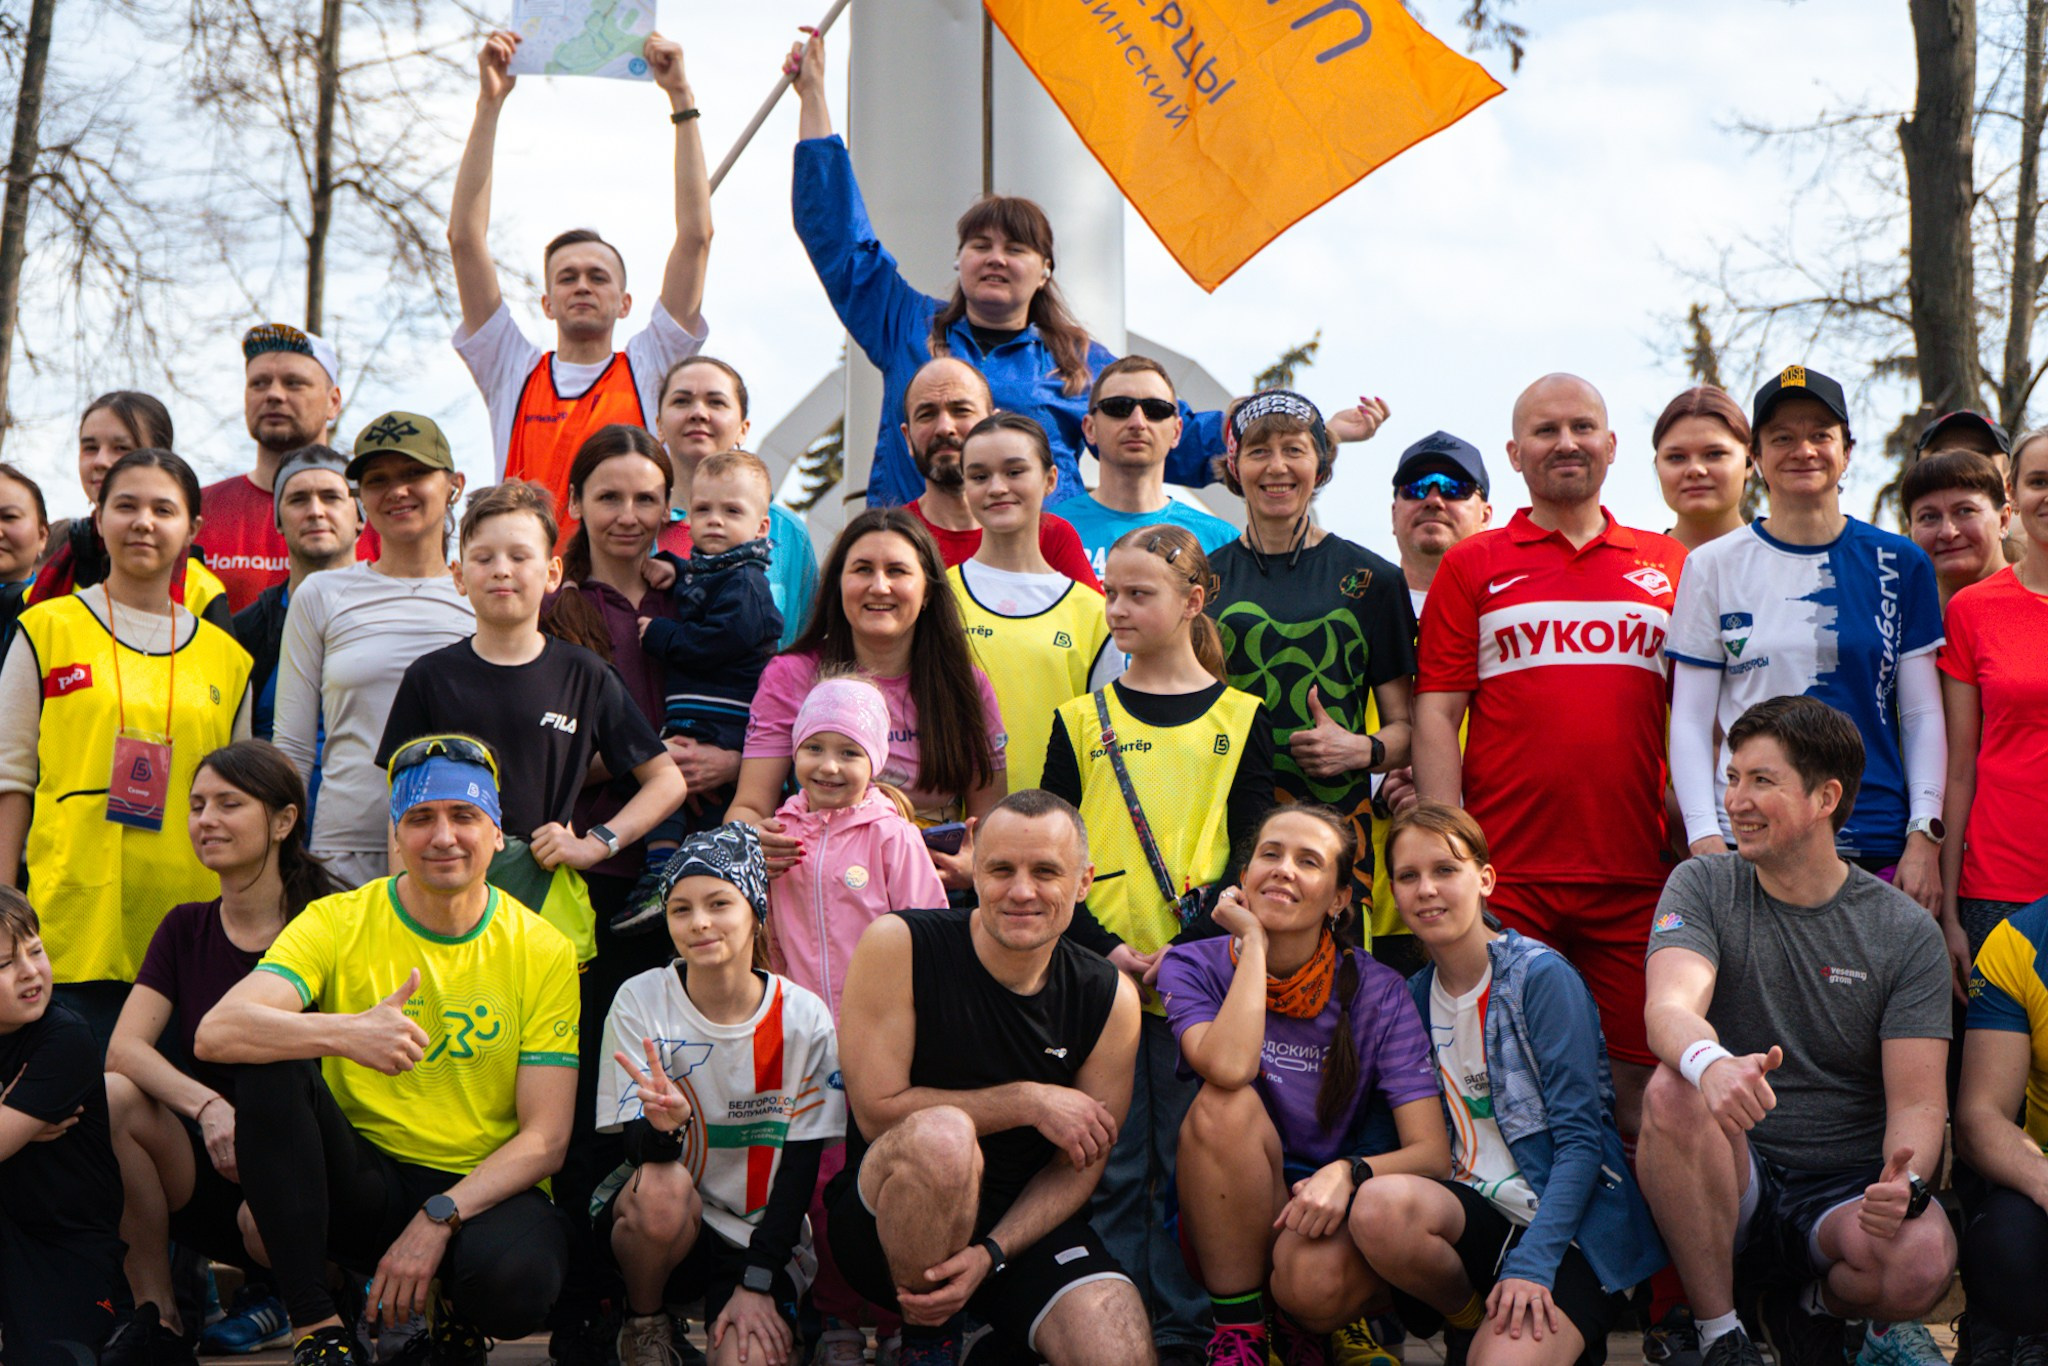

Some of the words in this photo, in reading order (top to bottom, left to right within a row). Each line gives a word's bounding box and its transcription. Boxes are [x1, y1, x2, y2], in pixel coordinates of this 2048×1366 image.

[1081, 0, 1190, 129] ИНСКИЙ
[1137, 0, 1236, 105] РЦЫ
[1494, 612, 1666, 663] ЛУКОЙЛ
[539, 711, 577, 735] FILA
